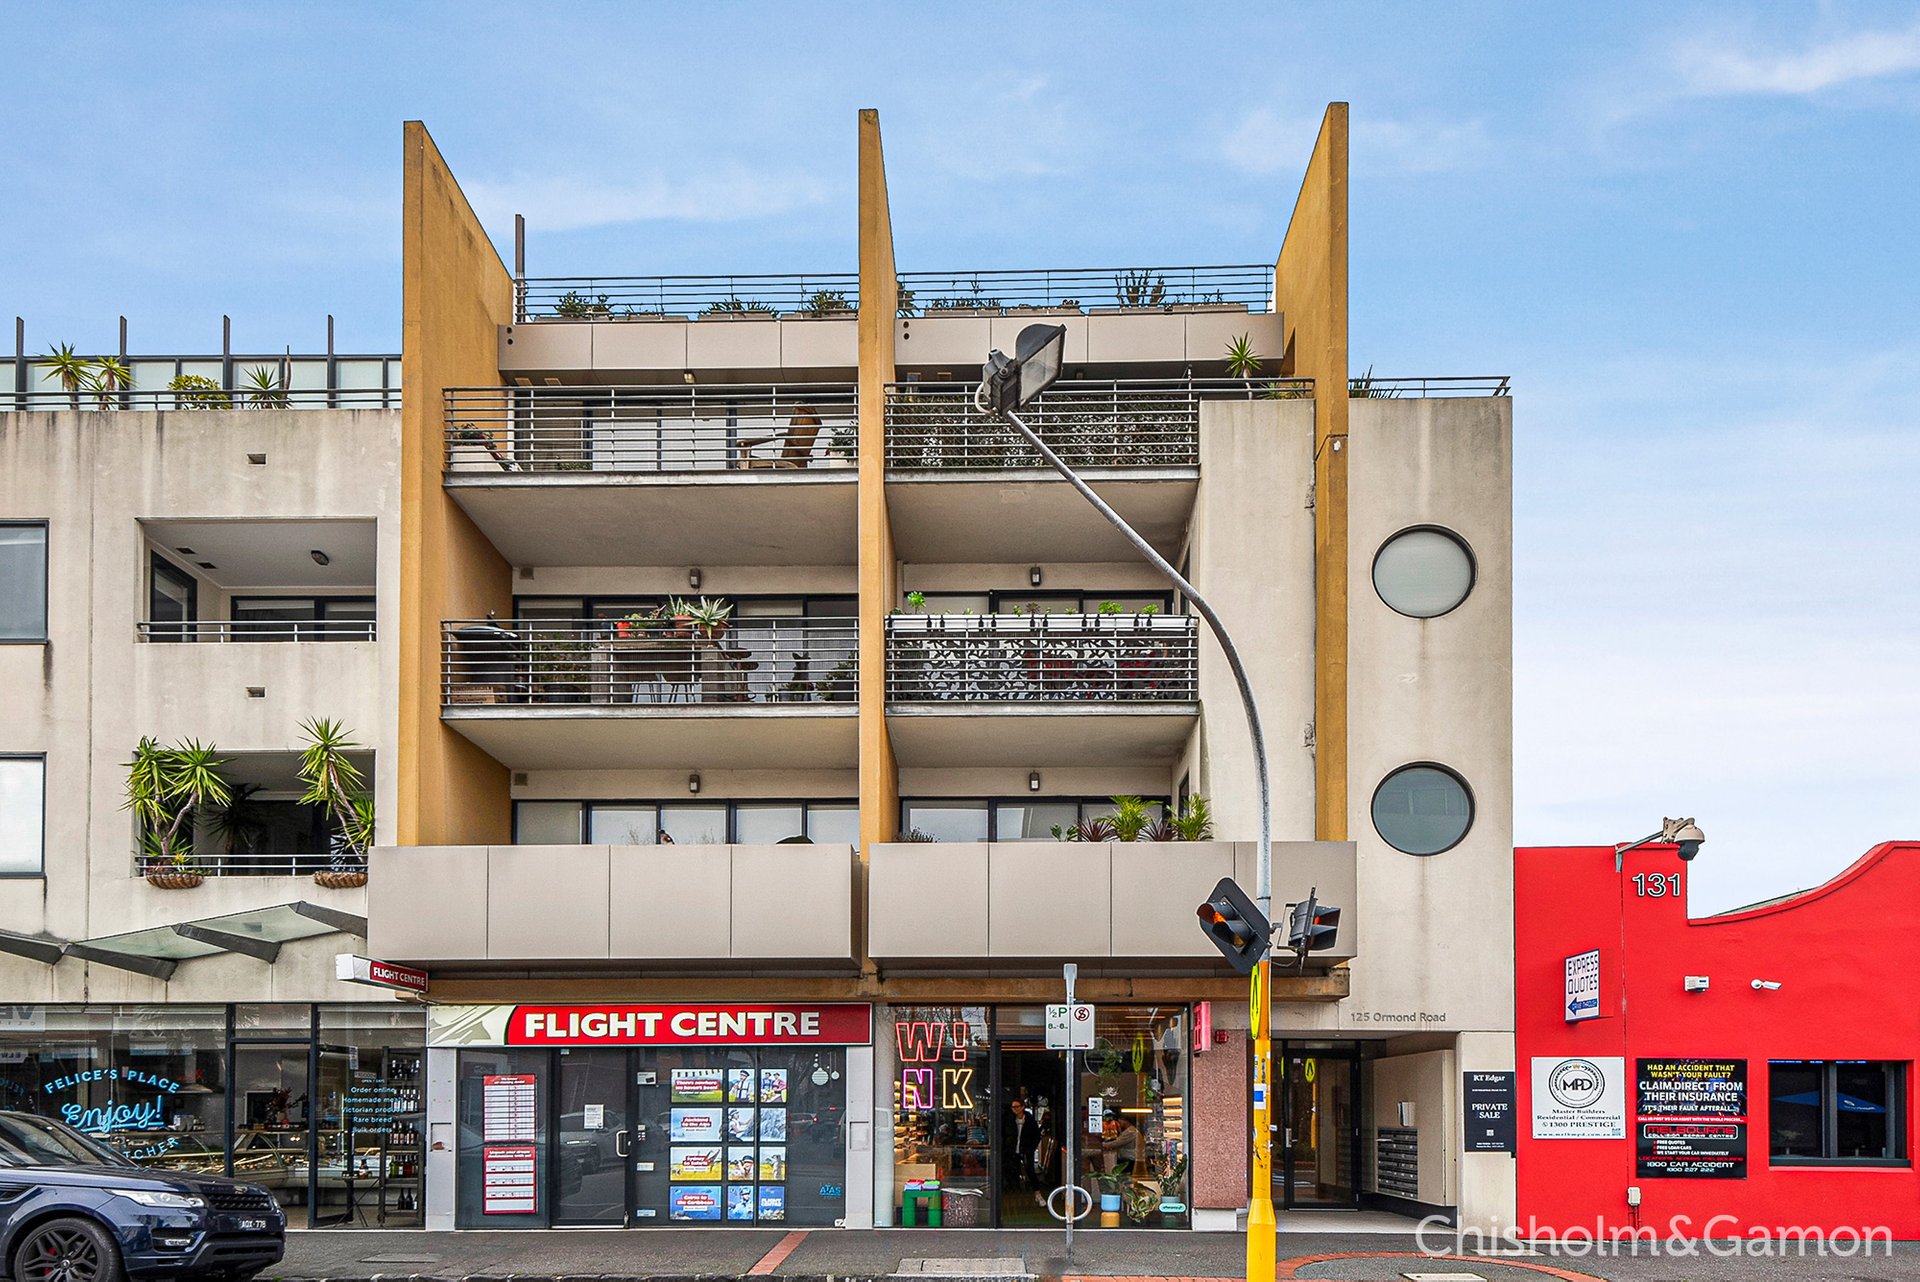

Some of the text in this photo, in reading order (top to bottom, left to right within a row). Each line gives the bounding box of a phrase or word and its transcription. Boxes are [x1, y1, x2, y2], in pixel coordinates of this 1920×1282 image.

[1632, 873, 1680, 897] 131
[1568, 954, 1598, 976] EXPRESS
[373, 966, 426, 986] FLIGHT CENTRE
[1568, 973, 1598, 994] QUOTES
[525, 1012, 820, 1037] FLIGHT CENTRE
[1351, 1012, 1446, 1022] 125 Ormond Road
[44, 1069, 118, 1094] FELICE'S
[127, 1070, 180, 1094] PLACE
[1485, 1074, 1505, 1083] Edgar
[1562, 1079, 1593, 1091] MPD
[1639, 1081, 1743, 1091] CLAIM DIRECT FROM
[1645, 1092, 1738, 1101] THEIR INSURANCE
[61, 1094, 163, 1133] Enjoy!
[1471, 1103, 1508, 1111] PRIVATE
[1647, 1126, 1735, 1134] MELBOURNE
